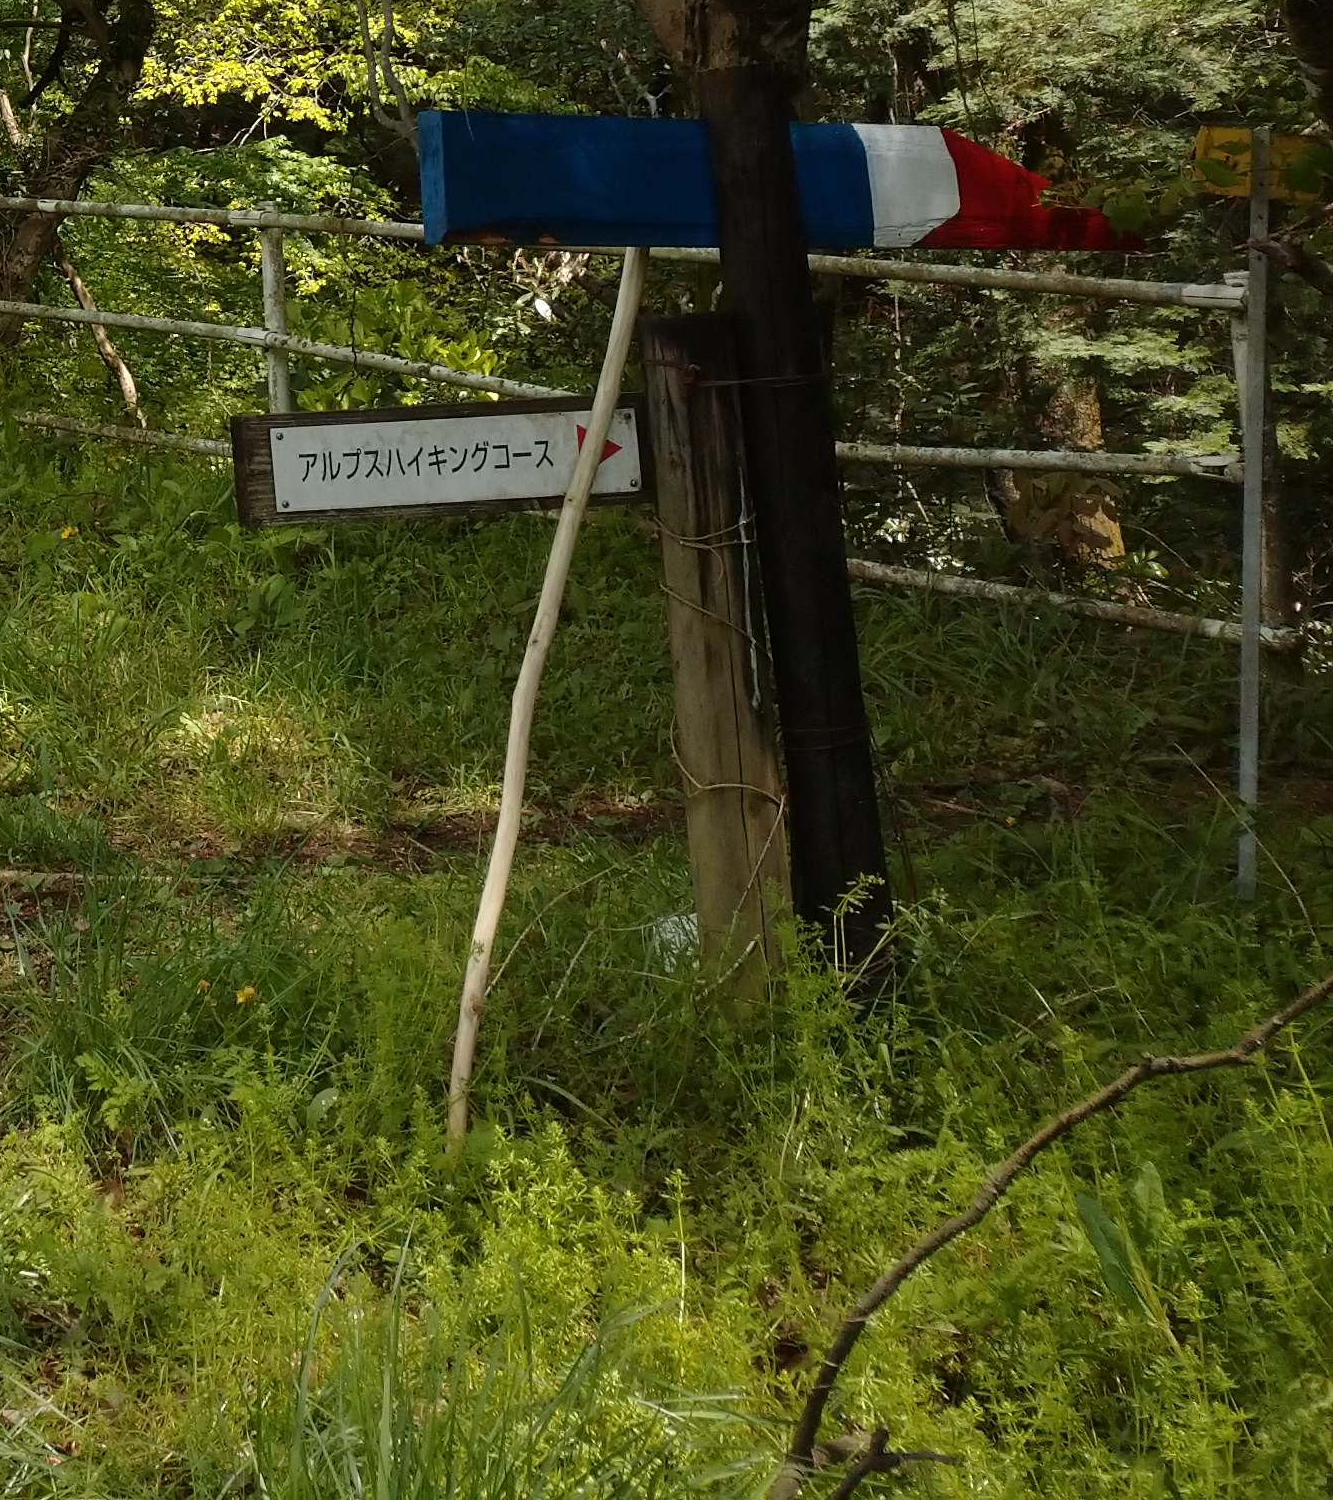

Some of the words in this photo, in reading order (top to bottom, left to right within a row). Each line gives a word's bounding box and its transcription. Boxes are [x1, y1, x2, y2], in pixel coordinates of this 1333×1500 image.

[298, 439, 555, 483] アルプスハイキングコース
